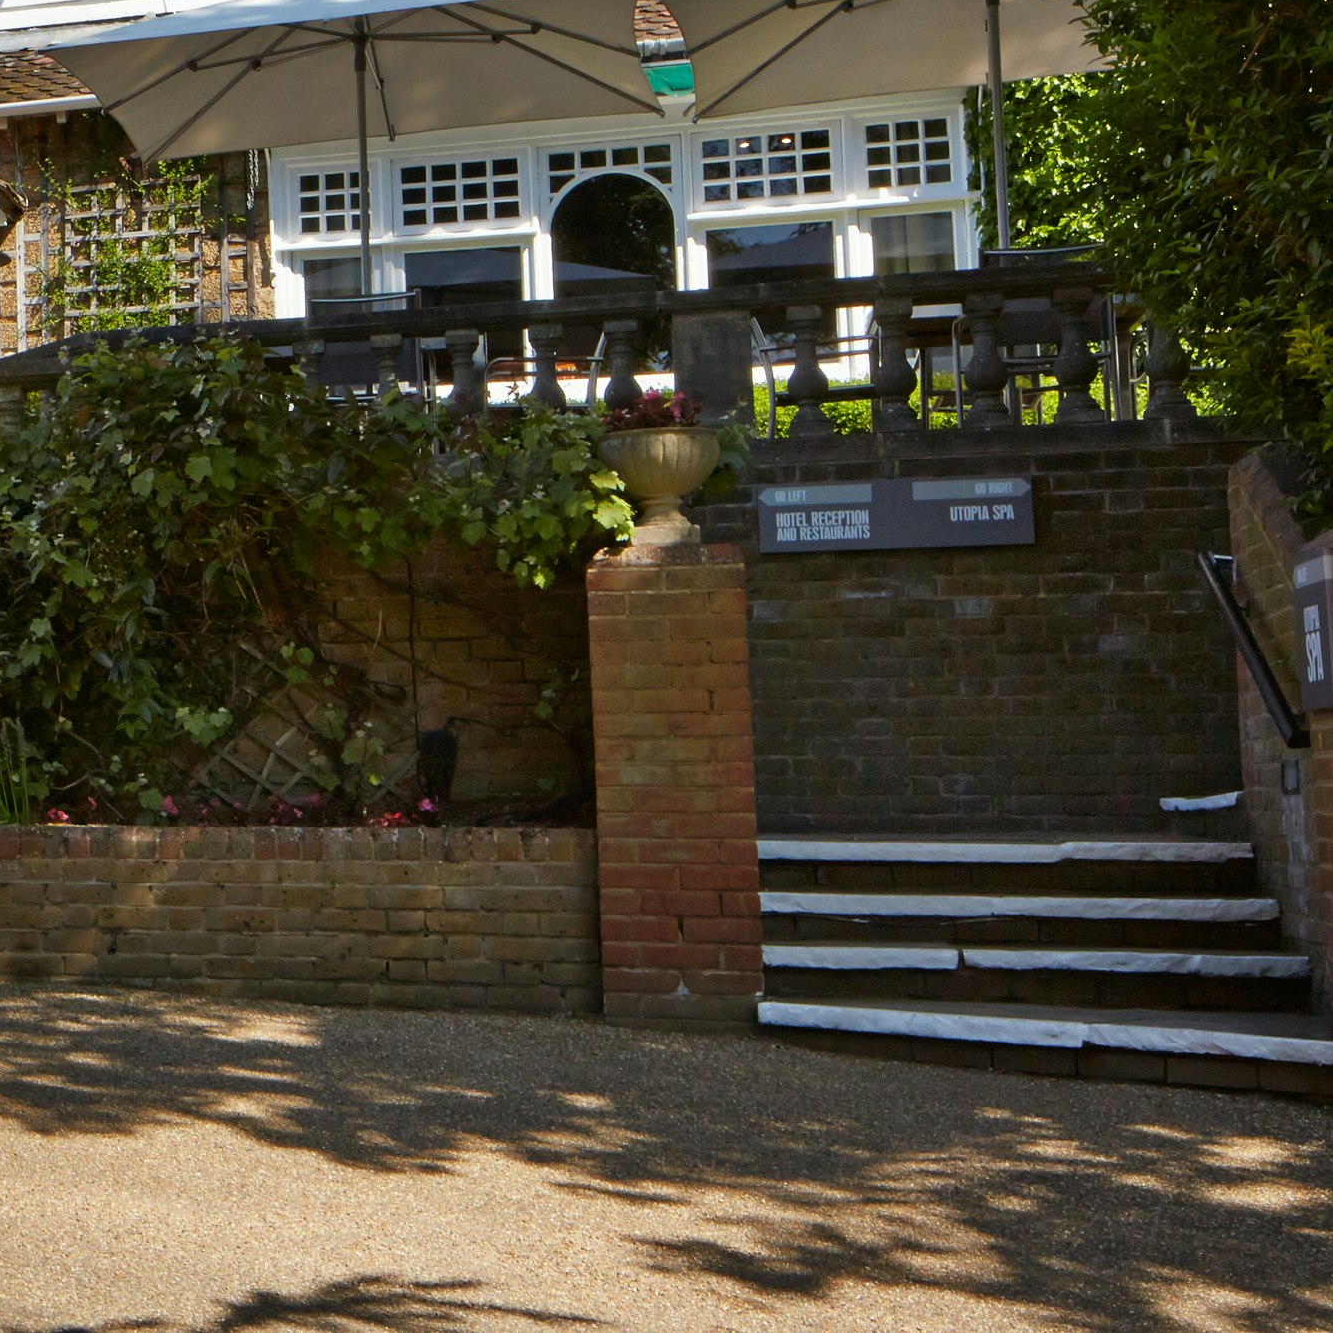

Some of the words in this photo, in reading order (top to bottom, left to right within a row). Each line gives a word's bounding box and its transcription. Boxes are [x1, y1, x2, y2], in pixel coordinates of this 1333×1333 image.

[775, 491, 786, 502] GO
[788, 490, 806, 502] LEFT
[975, 483, 986, 494] GO
[988, 482, 1012, 494] RIGHT
[776, 512, 809, 527] HOTEL
[811, 510, 869, 526] RECEPTION
[950, 505, 989, 521] UTOPIA
[992, 504, 1015, 520] SPA
[777, 527, 797, 541] AND
[800, 525, 870, 540] RESTAURANTS
[1306, 631, 1324, 683] SPA
